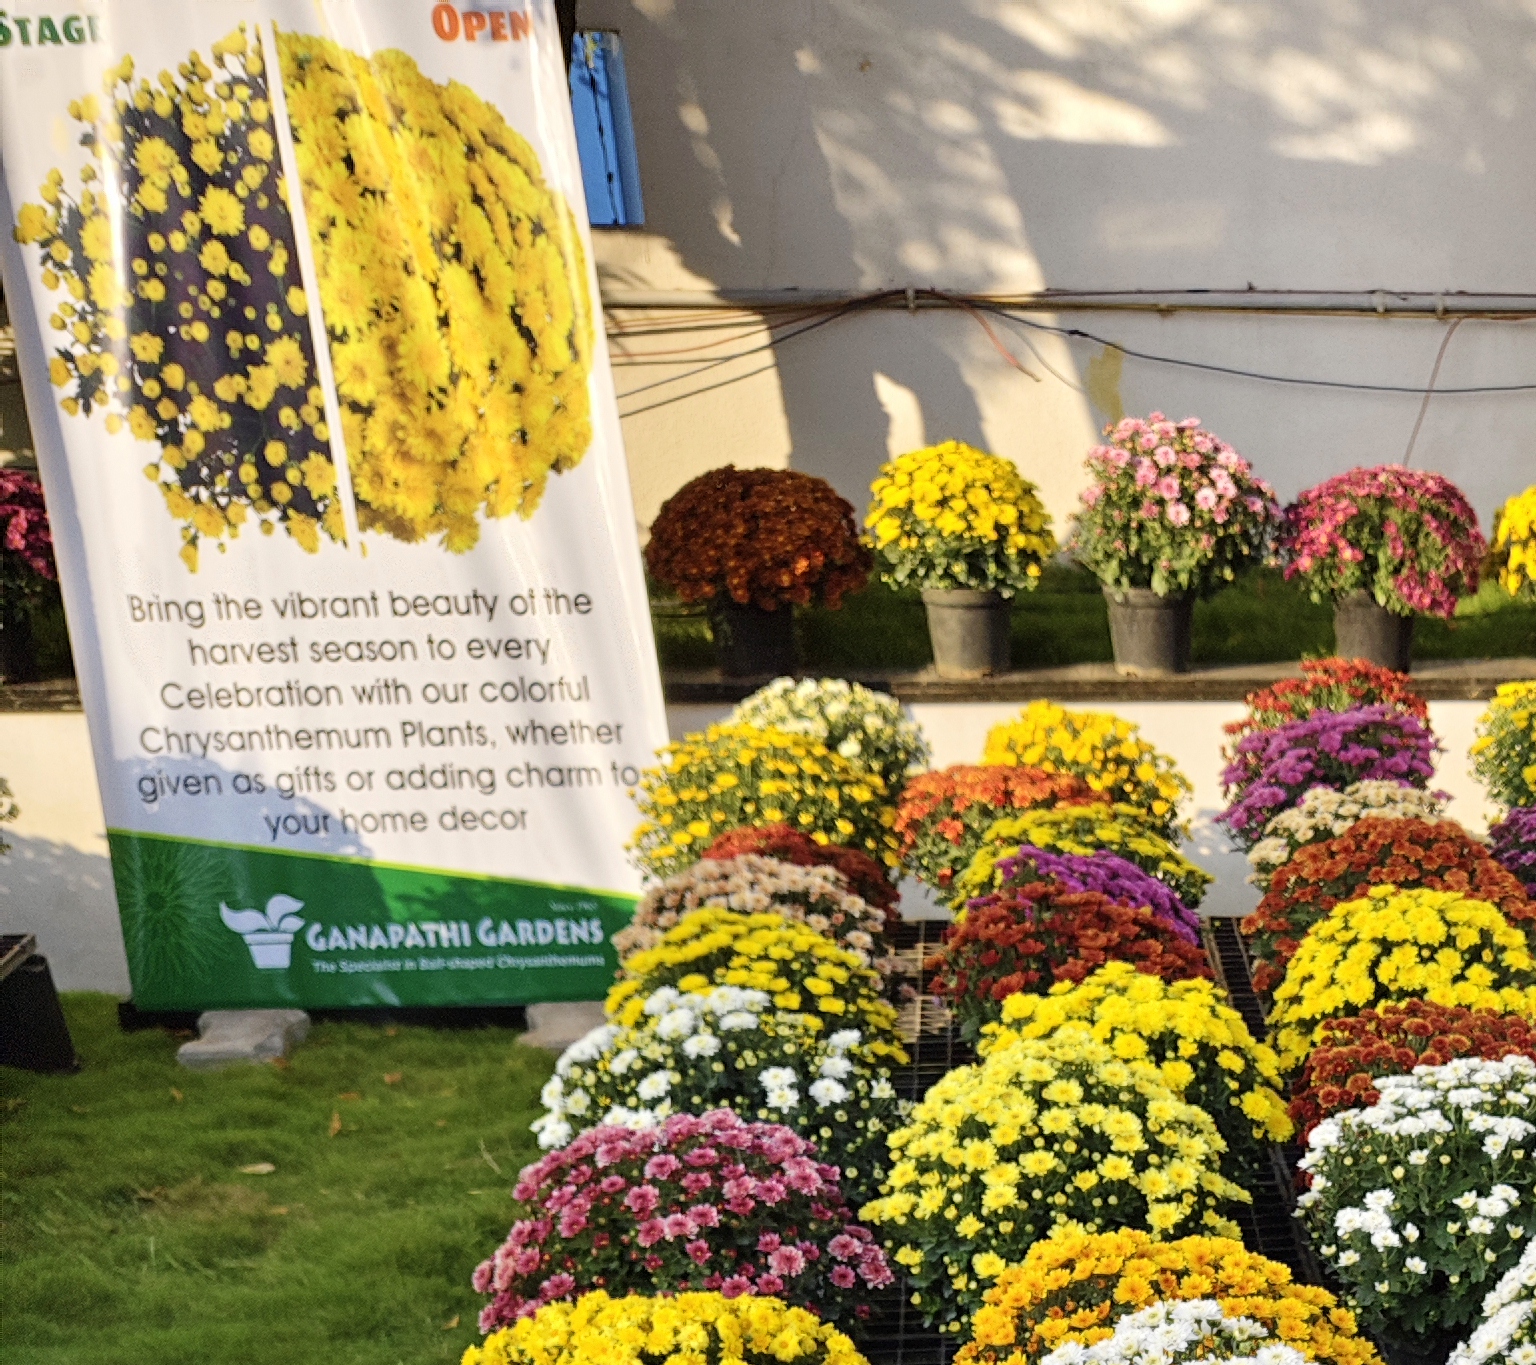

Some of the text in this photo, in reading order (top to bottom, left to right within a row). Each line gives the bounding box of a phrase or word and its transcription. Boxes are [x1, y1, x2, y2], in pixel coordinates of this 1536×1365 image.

[128, 587, 593, 629] Bring the vibrant beauty of the
[187, 634, 551, 666] harvest season to every
[160, 676, 590, 711] Celebration with our colorful
[140, 718, 625, 759] Chrysanthemum Plants, whether
[137, 761, 640, 803] given as gifts or adding charm to
[264, 805, 528, 842] your home decor
[305, 917, 605, 952] GANAPATHI GARDENS
